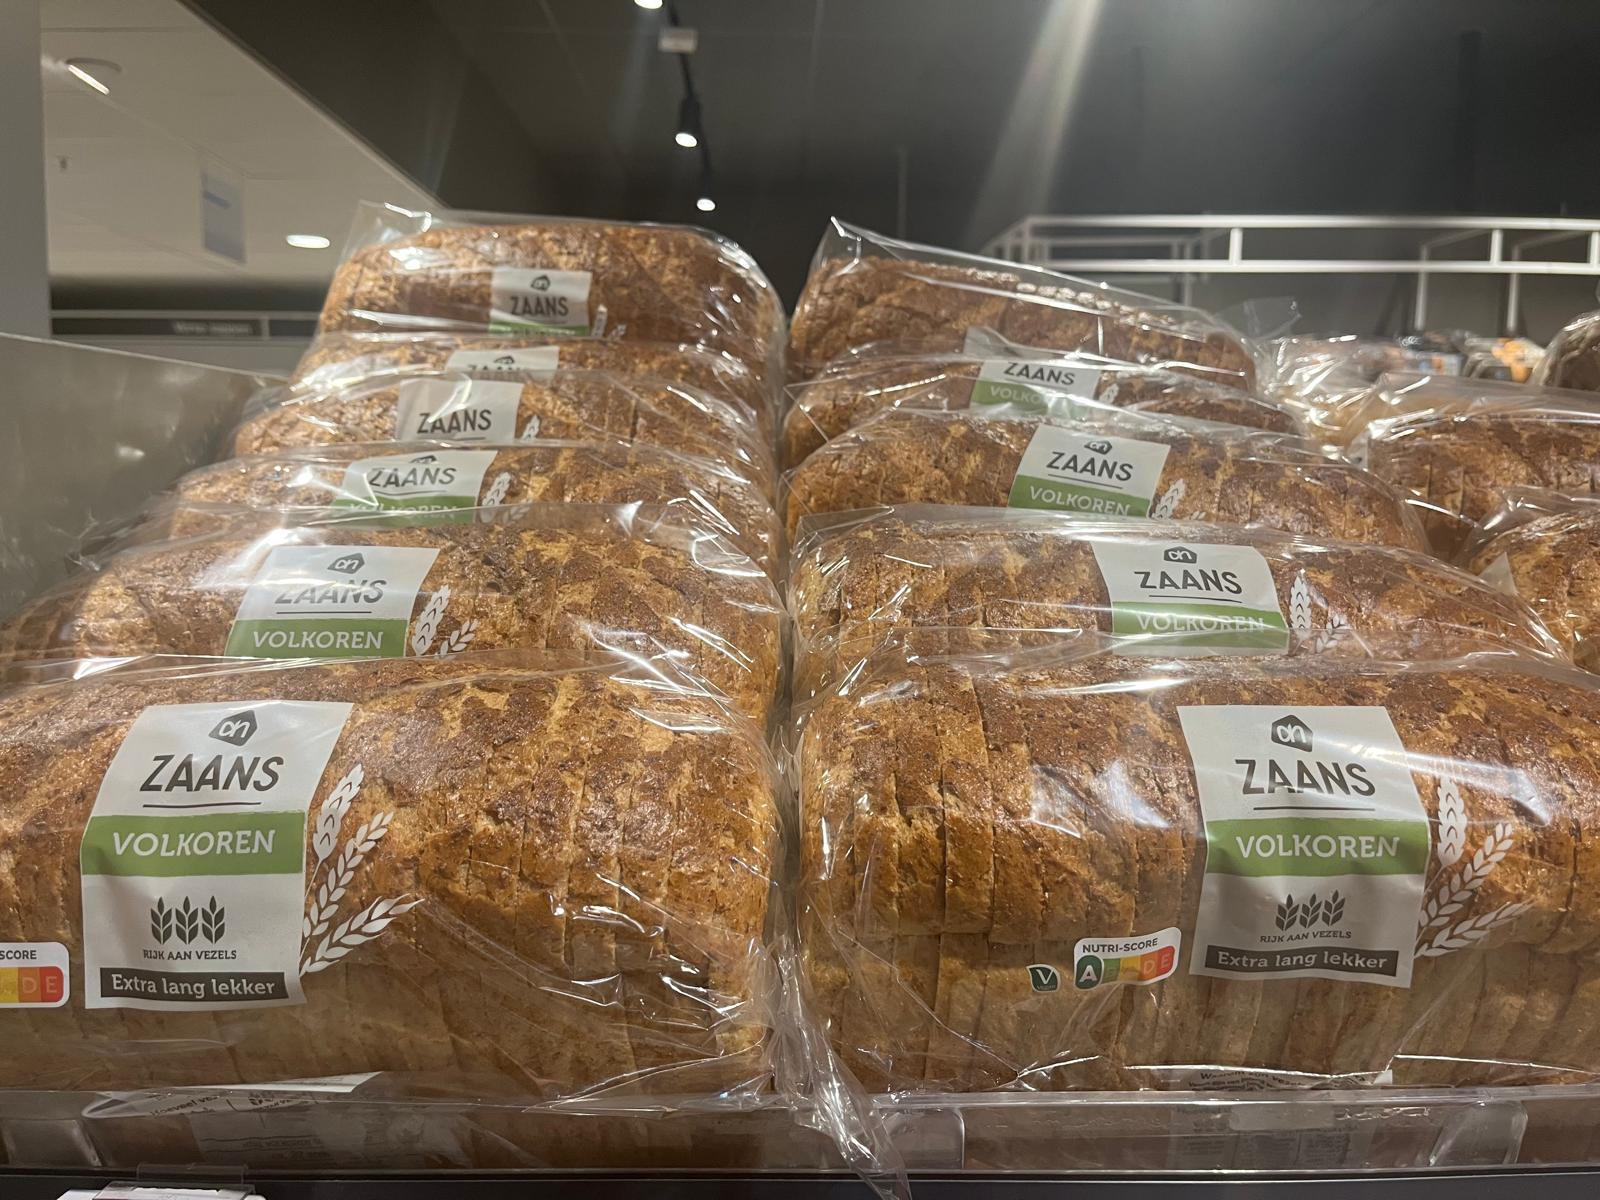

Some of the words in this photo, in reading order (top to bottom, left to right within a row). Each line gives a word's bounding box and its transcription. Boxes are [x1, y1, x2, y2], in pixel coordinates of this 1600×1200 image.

[510, 296, 569, 316] ZAANS
[1003, 361, 1076, 386] ZAANS
[417, 409, 493, 435] ZAANS
[369, 467, 457, 488] ZAANS
[1046, 451, 1134, 482] ZAANS
[1029, 485, 1131, 516] VOLKOREN
[275, 579, 388, 604] ZAANS
[1134, 569, 1243, 595] ZAANS
[1136, 612, 1265, 634] VOLKOREN
[253, 631, 384, 650] VOLKOREN
[139, 753, 285, 792] ZAANS
[1235, 758, 1376, 797] ZAANS
[112, 829, 276, 857] VOLKOREN
[1236, 834, 1400, 858] VOLKOREN
[1082, 937, 1158, 954] NUTRI-SCORE
[1260, 933, 1284, 944] RIJK
[1286, 931, 1310, 943] AAN
[1312, 930, 1352, 940] VEZELS
[143, 949, 167, 960] RIJK
[167, 950, 192, 961] AAN
[196, 949, 237, 960] VEZELS
[1217, 951, 1269, 968] Extra
[1275, 950, 1317, 967] lang
[1323, 950, 1388, 969] lekker
[112, 973, 157, 993] Extra
[162, 978, 206, 999] lang
[211, 978, 276, 995] lekker
